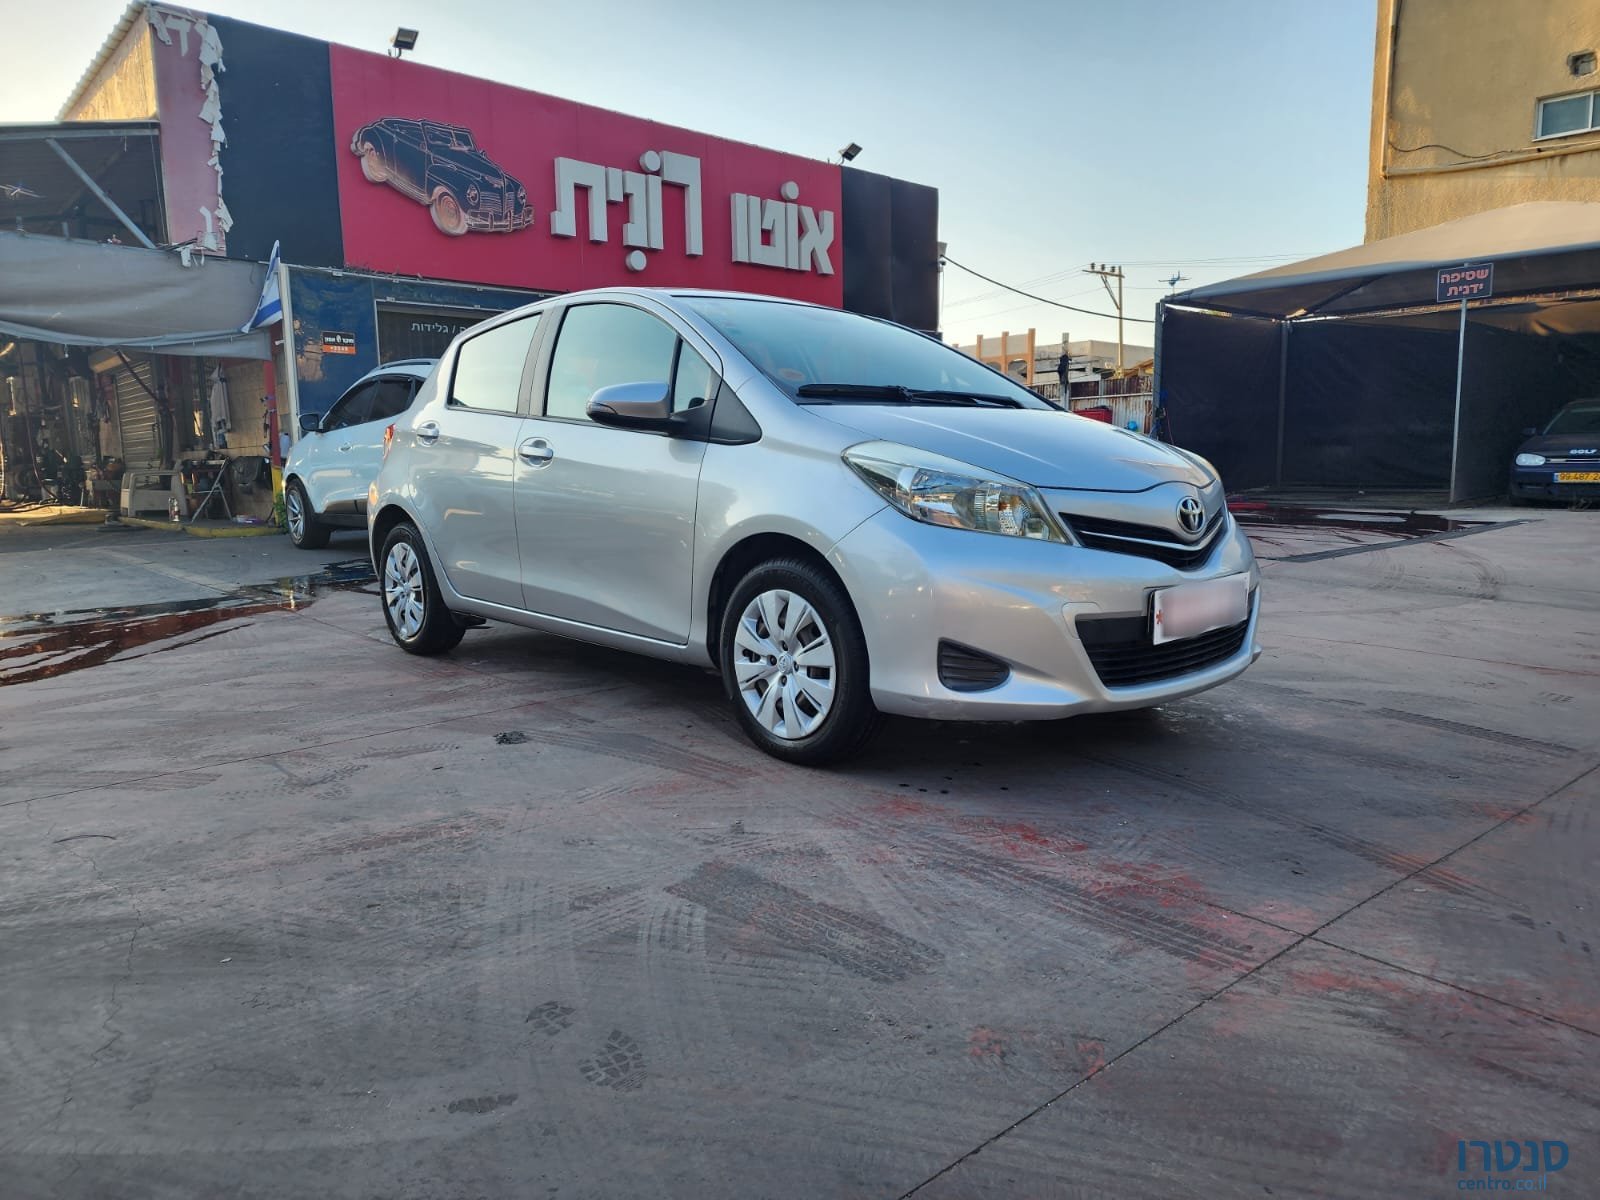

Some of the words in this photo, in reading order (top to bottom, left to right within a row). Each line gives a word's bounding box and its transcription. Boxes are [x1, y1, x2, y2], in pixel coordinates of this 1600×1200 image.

[1440, 268, 1489, 284] שטיפה
[1446, 283, 1484, 297] ידנית
[411, 322, 449, 334] גלידות
